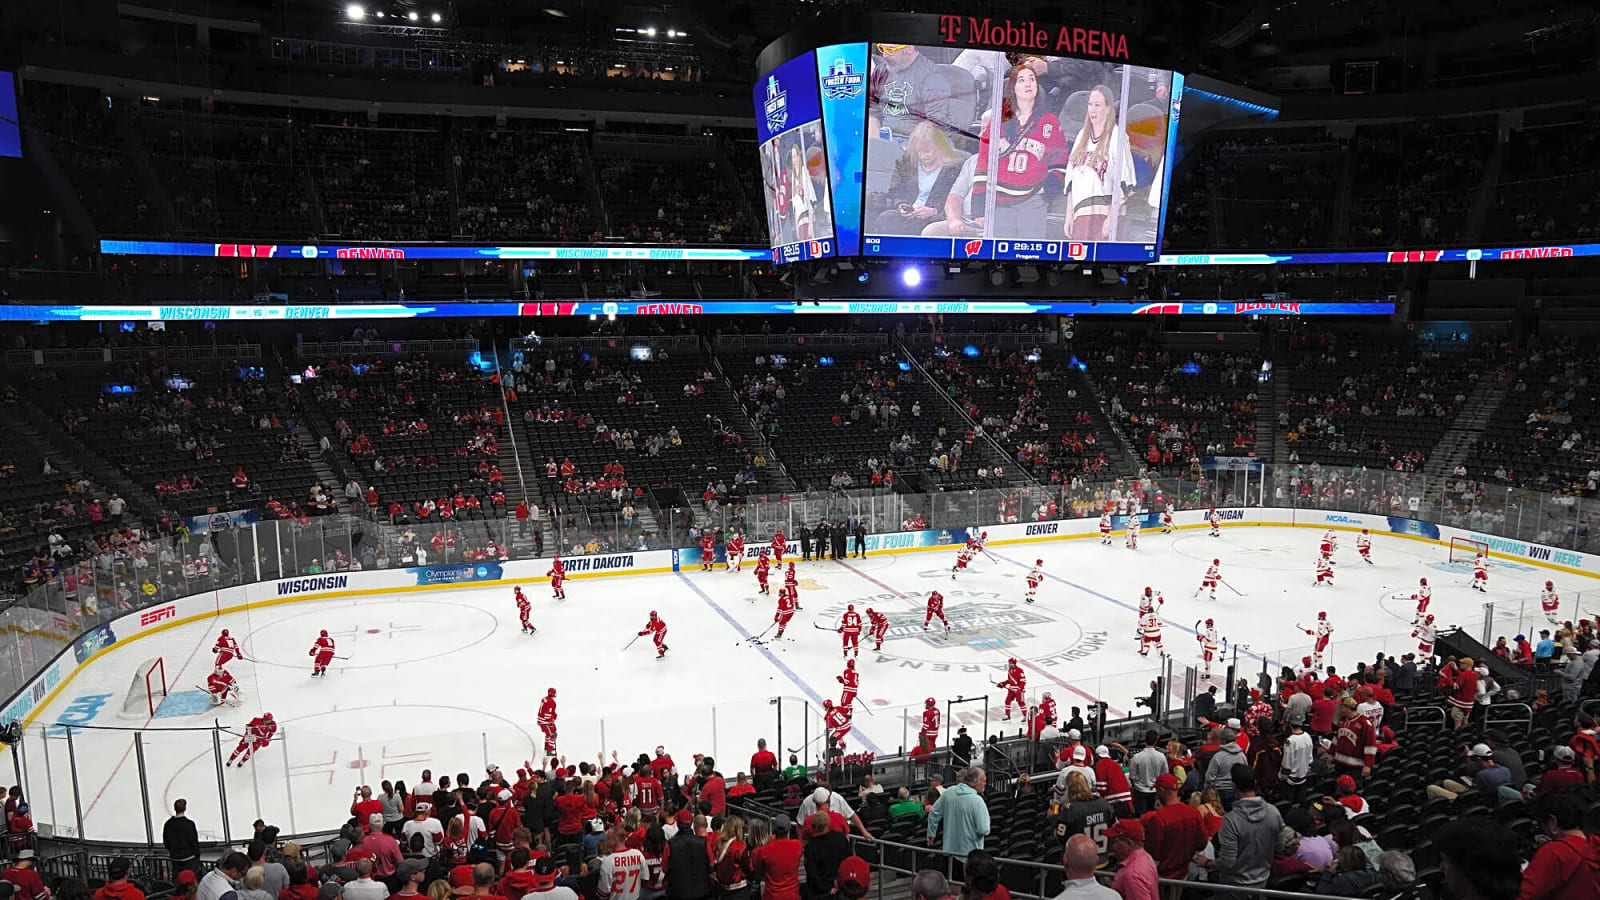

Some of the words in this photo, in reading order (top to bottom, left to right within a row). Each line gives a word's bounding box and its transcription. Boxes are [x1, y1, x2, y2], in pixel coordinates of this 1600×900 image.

[968, 17, 1048, 49] Mobile
[1056, 26, 1129, 60] ARENA
[1043, 124, 1053, 138] C
[1008, 152, 1028, 174] 10
[556, 249, 608, 259] WISCONSIN
[649, 249, 683, 259] DENVER
[822, 241, 830, 254] 0
[998, 242, 1009, 253] 0
[1014, 243, 1042, 251] 29:15
[1047, 243, 1057, 254] 0
[1177, 255, 1210, 265] DENVER
[160, 306, 231, 320] WISCONSIN
[285, 306, 329, 319] DENVER
[848, 303, 898, 313] WISCONSIN
[936, 303, 969, 313] DENVER
[1026, 523, 1058, 536] DENVER
[882, 533, 914, 549] FOUR
[562, 558, 590, 572] ORTH
[593, 555, 634, 570] DAKOTA
[1528, 545, 1551, 561] WIN
[1553, 551, 1584, 568] HERE
[277, 575, 348, 595] WISCONSIN
[141, 605, 176, 627] ESPN
[847, 616, 857, 627] 94
[33, 678, 46, 704] WIN
[832, 711, 846, 725] 19
[641, 789, 653, 804] 11
[1086, 812, 1104, 825] SMITH
[614, 855, 642, 867] BRINK
[611, 868, 641, 894] 27
